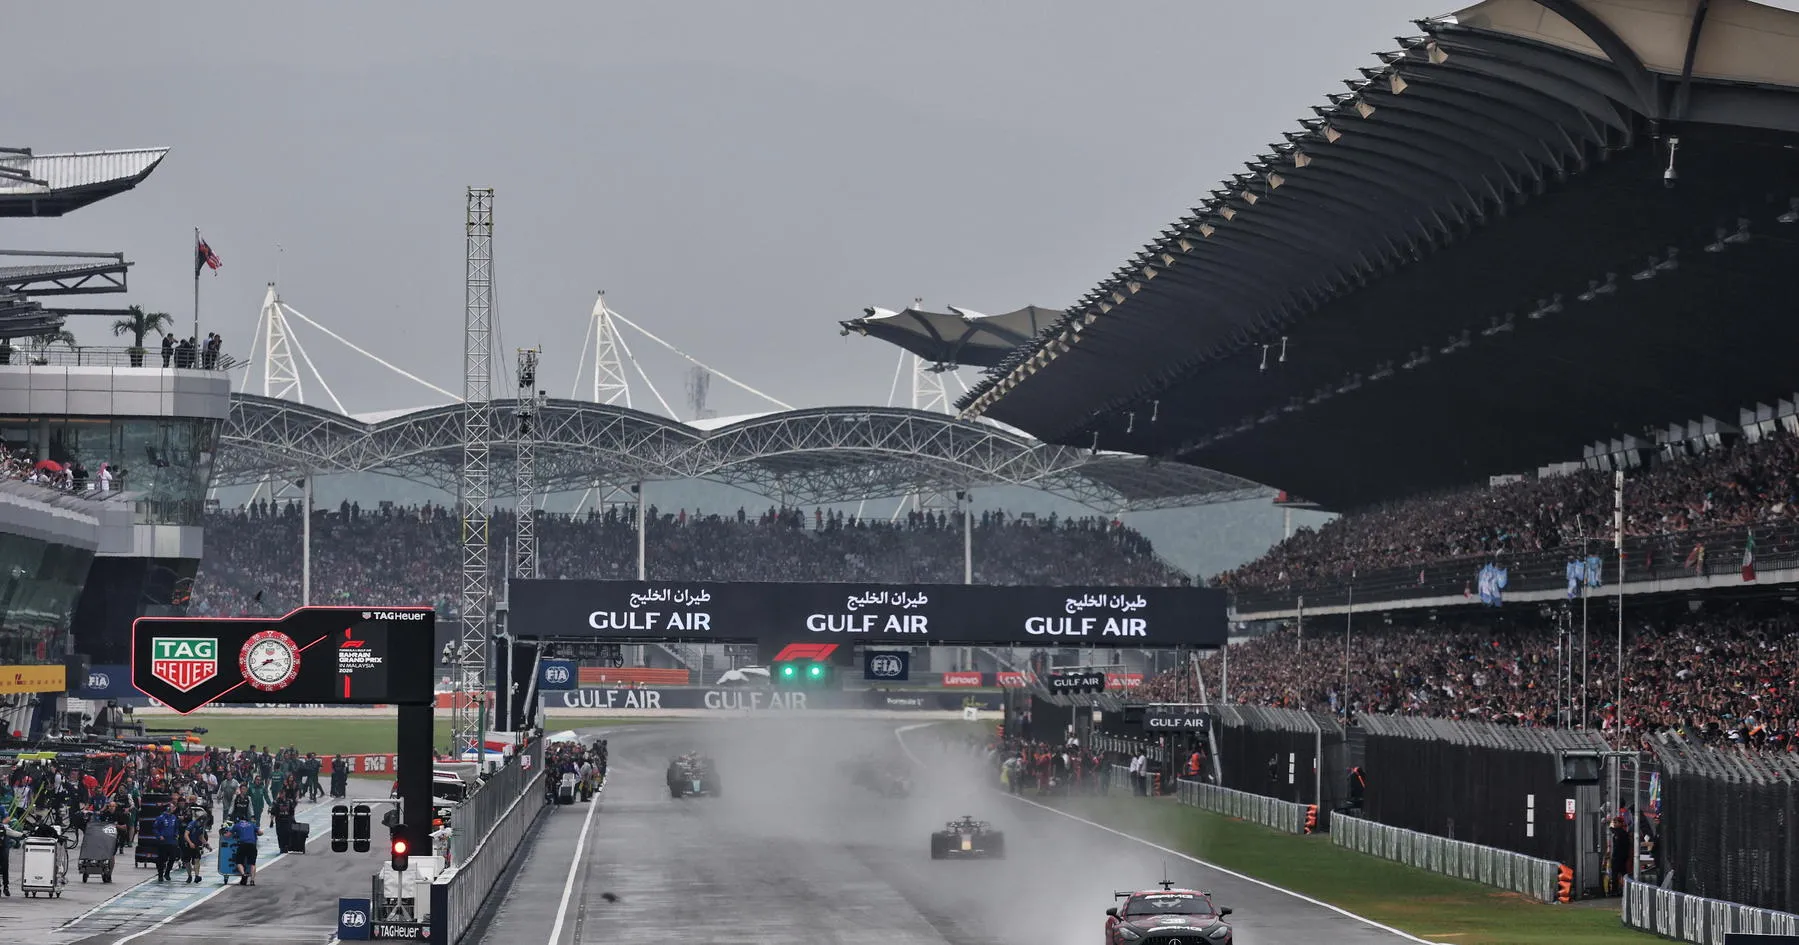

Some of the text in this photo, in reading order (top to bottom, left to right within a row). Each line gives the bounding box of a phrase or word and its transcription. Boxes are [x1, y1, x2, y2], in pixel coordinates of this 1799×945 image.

[629, 589, 710, 608] طيران الخليج
[847, 592, 928, 610] طيران الخليج
[1065, 594, 1147, 614] طيران الخليج
[588, 611, 711, 631] GULF AIR
[806, 614, 928, 634] GULF AIR
[1025, 617, 1147, 636] GULF AIR
[158, 641, 213, 658] TAG
[156, 661, 214, 688] HEUER
[546, 667, 567, 681] FIA
[870, 657, 900, 674] FIA
[88, 674, 108, 688] FIA
[944, 675, 980, 685] Lenovo
[1053, 677, 1099, 687] GULF AIR
[563, 690, 661, 709] GULF AIR
[704, 690, 807, 711] GULF AIR
[1150, 718, 1204, 728] GULF AIR
[343, 912, 364, 925] FIA
